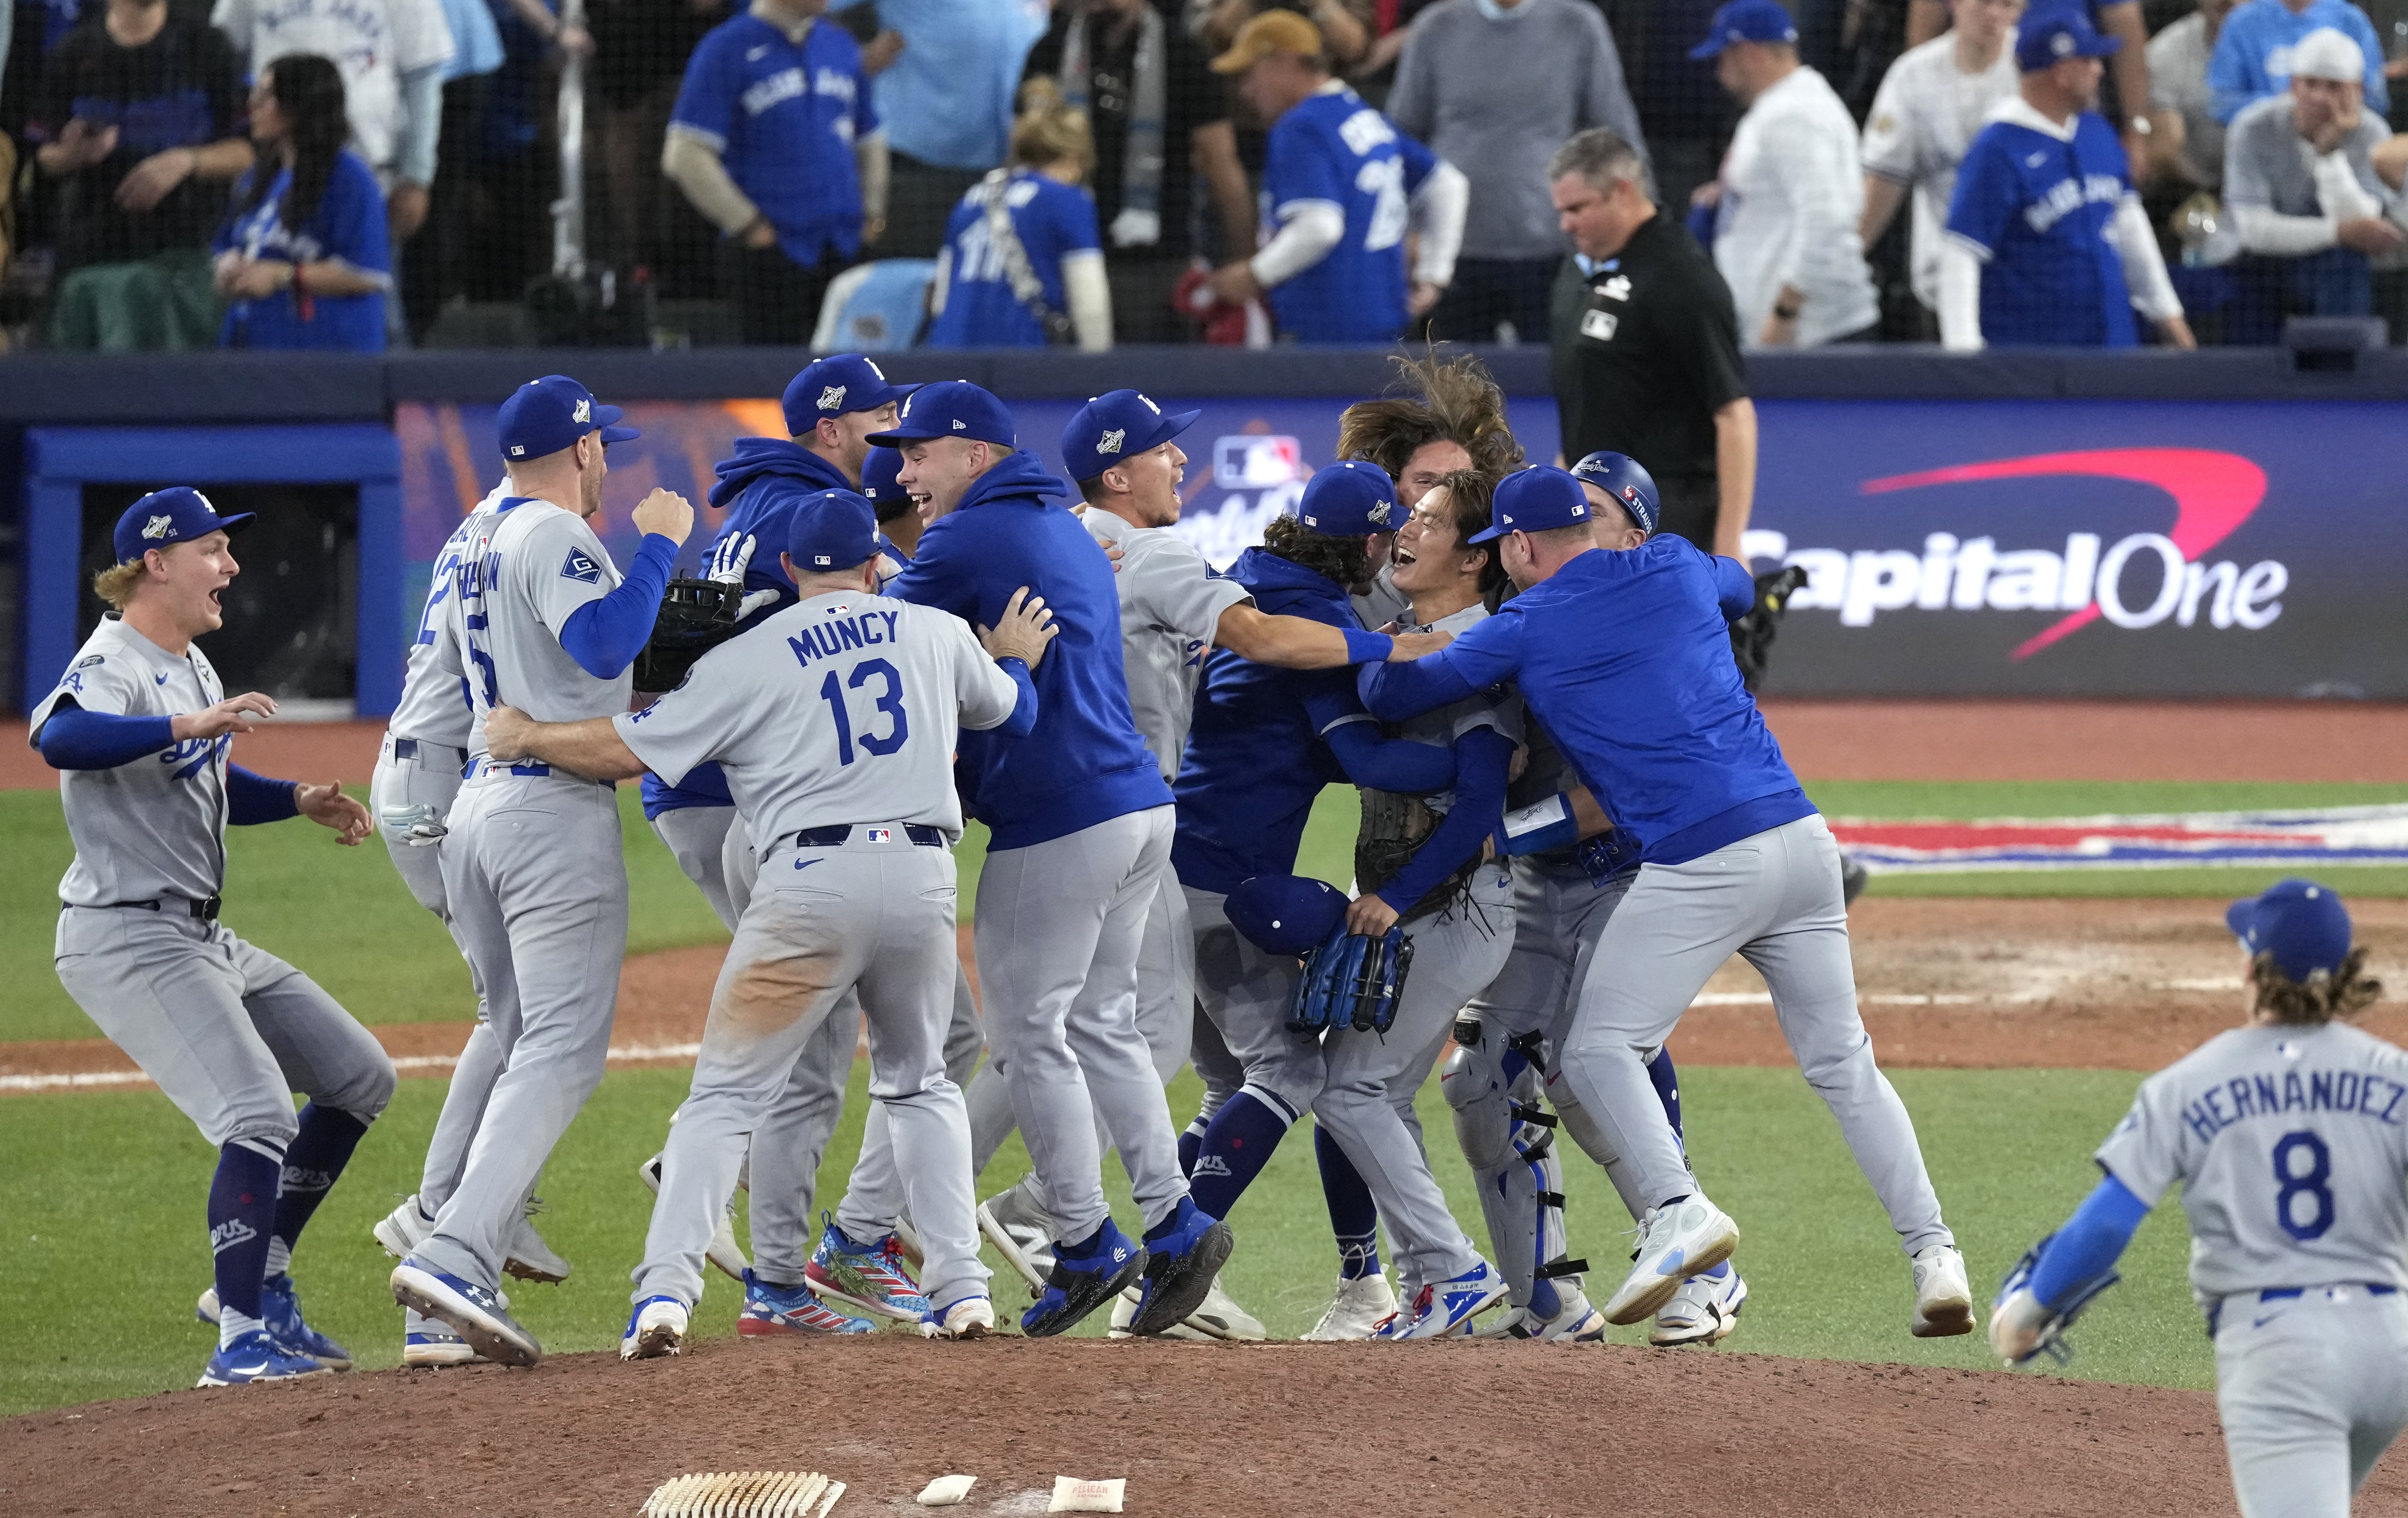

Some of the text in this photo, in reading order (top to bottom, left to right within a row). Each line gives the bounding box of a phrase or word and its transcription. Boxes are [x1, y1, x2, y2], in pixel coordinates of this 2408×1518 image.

[168, 528, 178, 537] 51
[1632, 497, 1652, 534] STRAUSS
[572, 557, 592, 571] G
[2097, 532, 2289, 629] One
[467, 610, 497, 710] 5
[787, 610, 898, 668] MUNCY
[820, 657, 909, 766] 13
[1520, 805, 1543, 823] Dodgers
[2181, 1068, 2406, 1145] HERNANDEZ
[2272, 1129, 2336, 1239] 8
[1072, 1485, 1108, 1494] PELICAN
